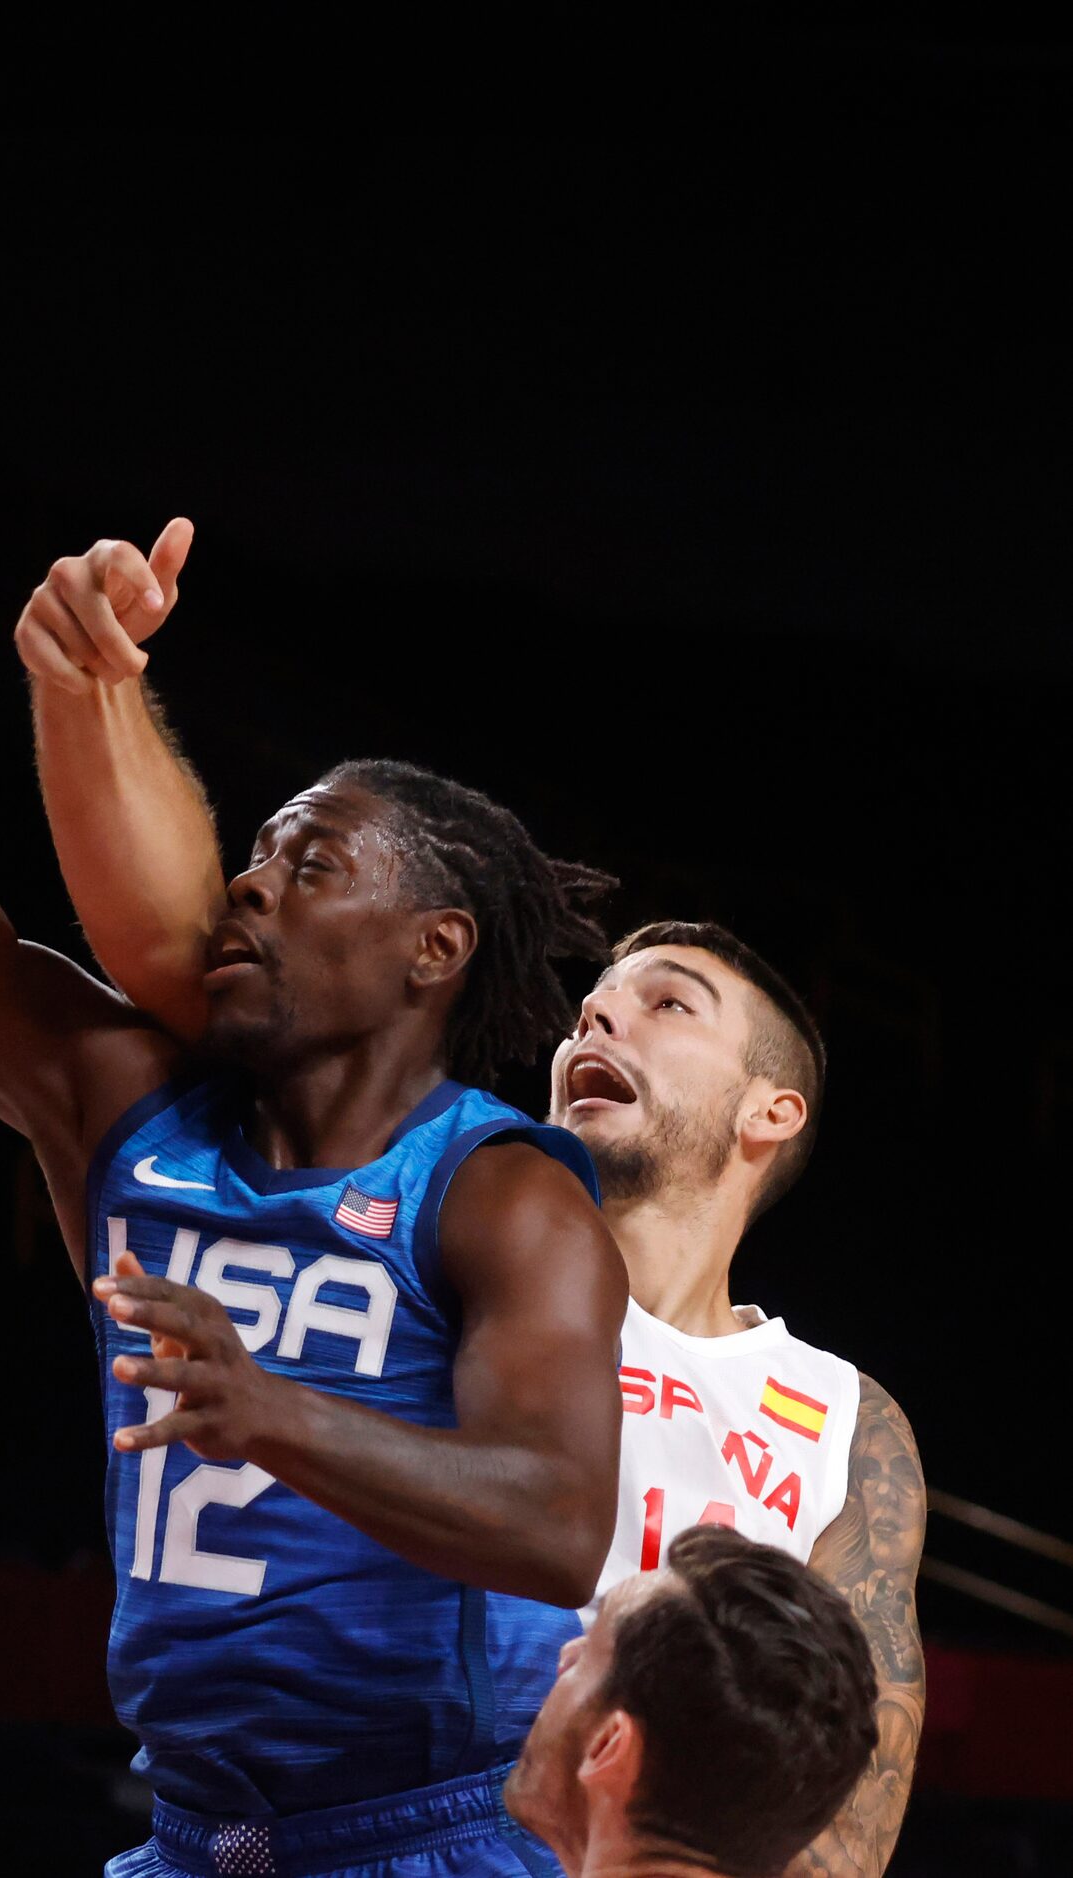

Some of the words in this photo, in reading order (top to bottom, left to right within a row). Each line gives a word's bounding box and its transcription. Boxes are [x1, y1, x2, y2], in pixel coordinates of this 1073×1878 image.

[107, 1217, 399, 1378] USA
[130, 1386, 278, 1596] 12
[640, 1487, 736, 1571] 1
